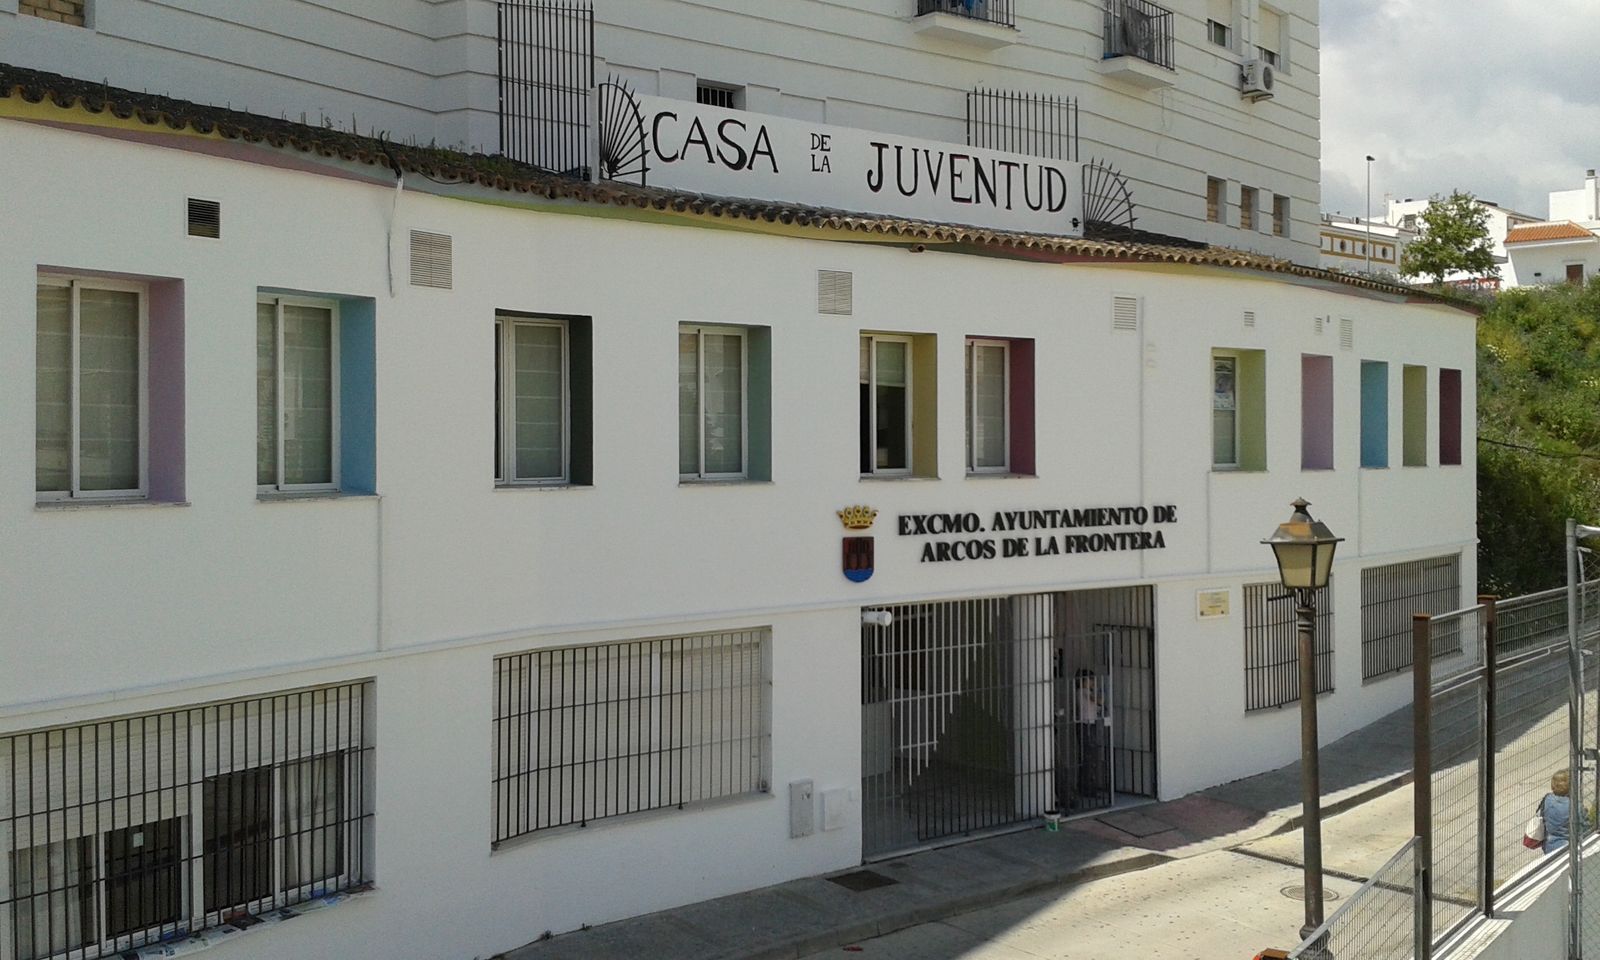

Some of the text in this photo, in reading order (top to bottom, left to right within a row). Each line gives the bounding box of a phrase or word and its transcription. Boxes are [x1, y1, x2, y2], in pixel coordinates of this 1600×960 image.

[652, 111, 1067, 213] CASA DE LA JUVENTUD
[898, 505, 1178, 536] EXCMO. AYUNTAMIENTO DE
[921, 530, 1166, 563] ARCOS DE LA FRONTERA
